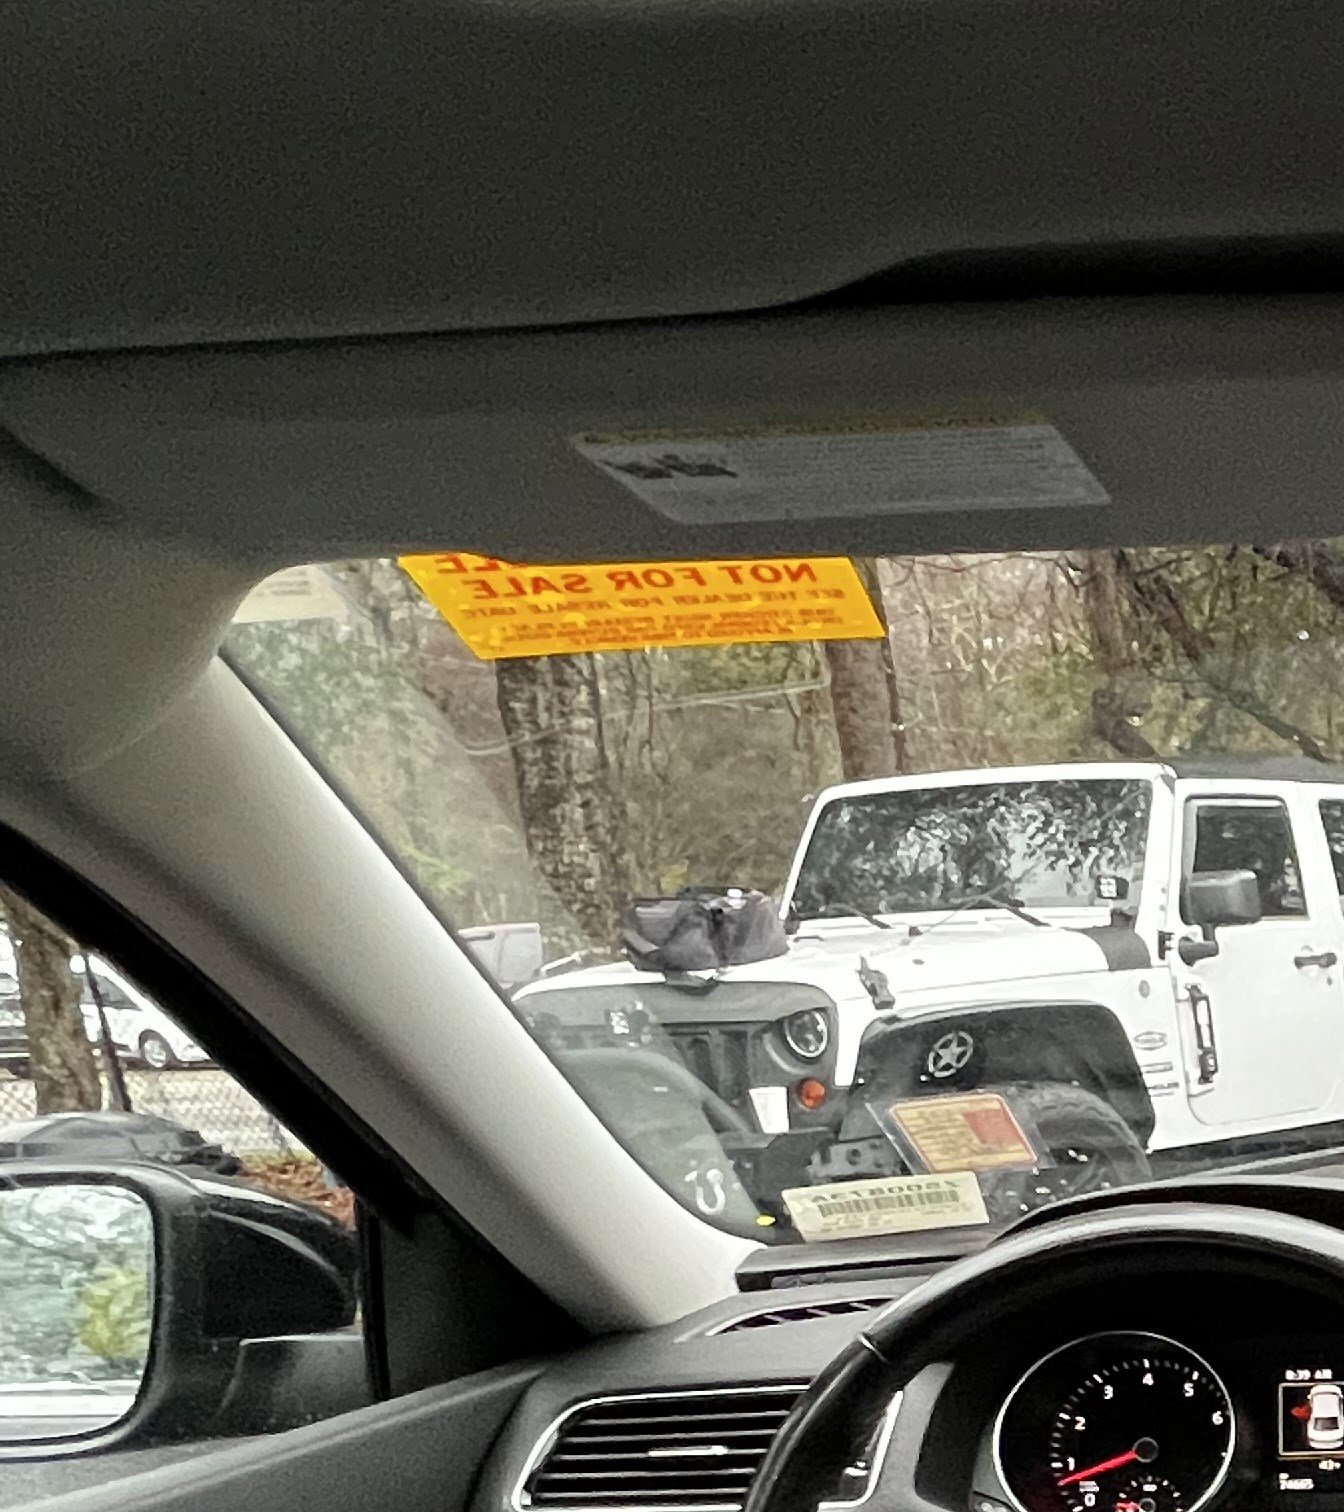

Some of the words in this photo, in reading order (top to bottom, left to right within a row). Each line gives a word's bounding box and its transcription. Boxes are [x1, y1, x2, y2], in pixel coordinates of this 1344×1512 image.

[1142, 1373, 1154, 1386] 4
[1104, 1385, 1114, 1400] 3
[1183, 1382, 1195, 1398] 5
[1074, 1416, 1086, 1431] 2
[1212, 1411, 1223, 1425] 6
